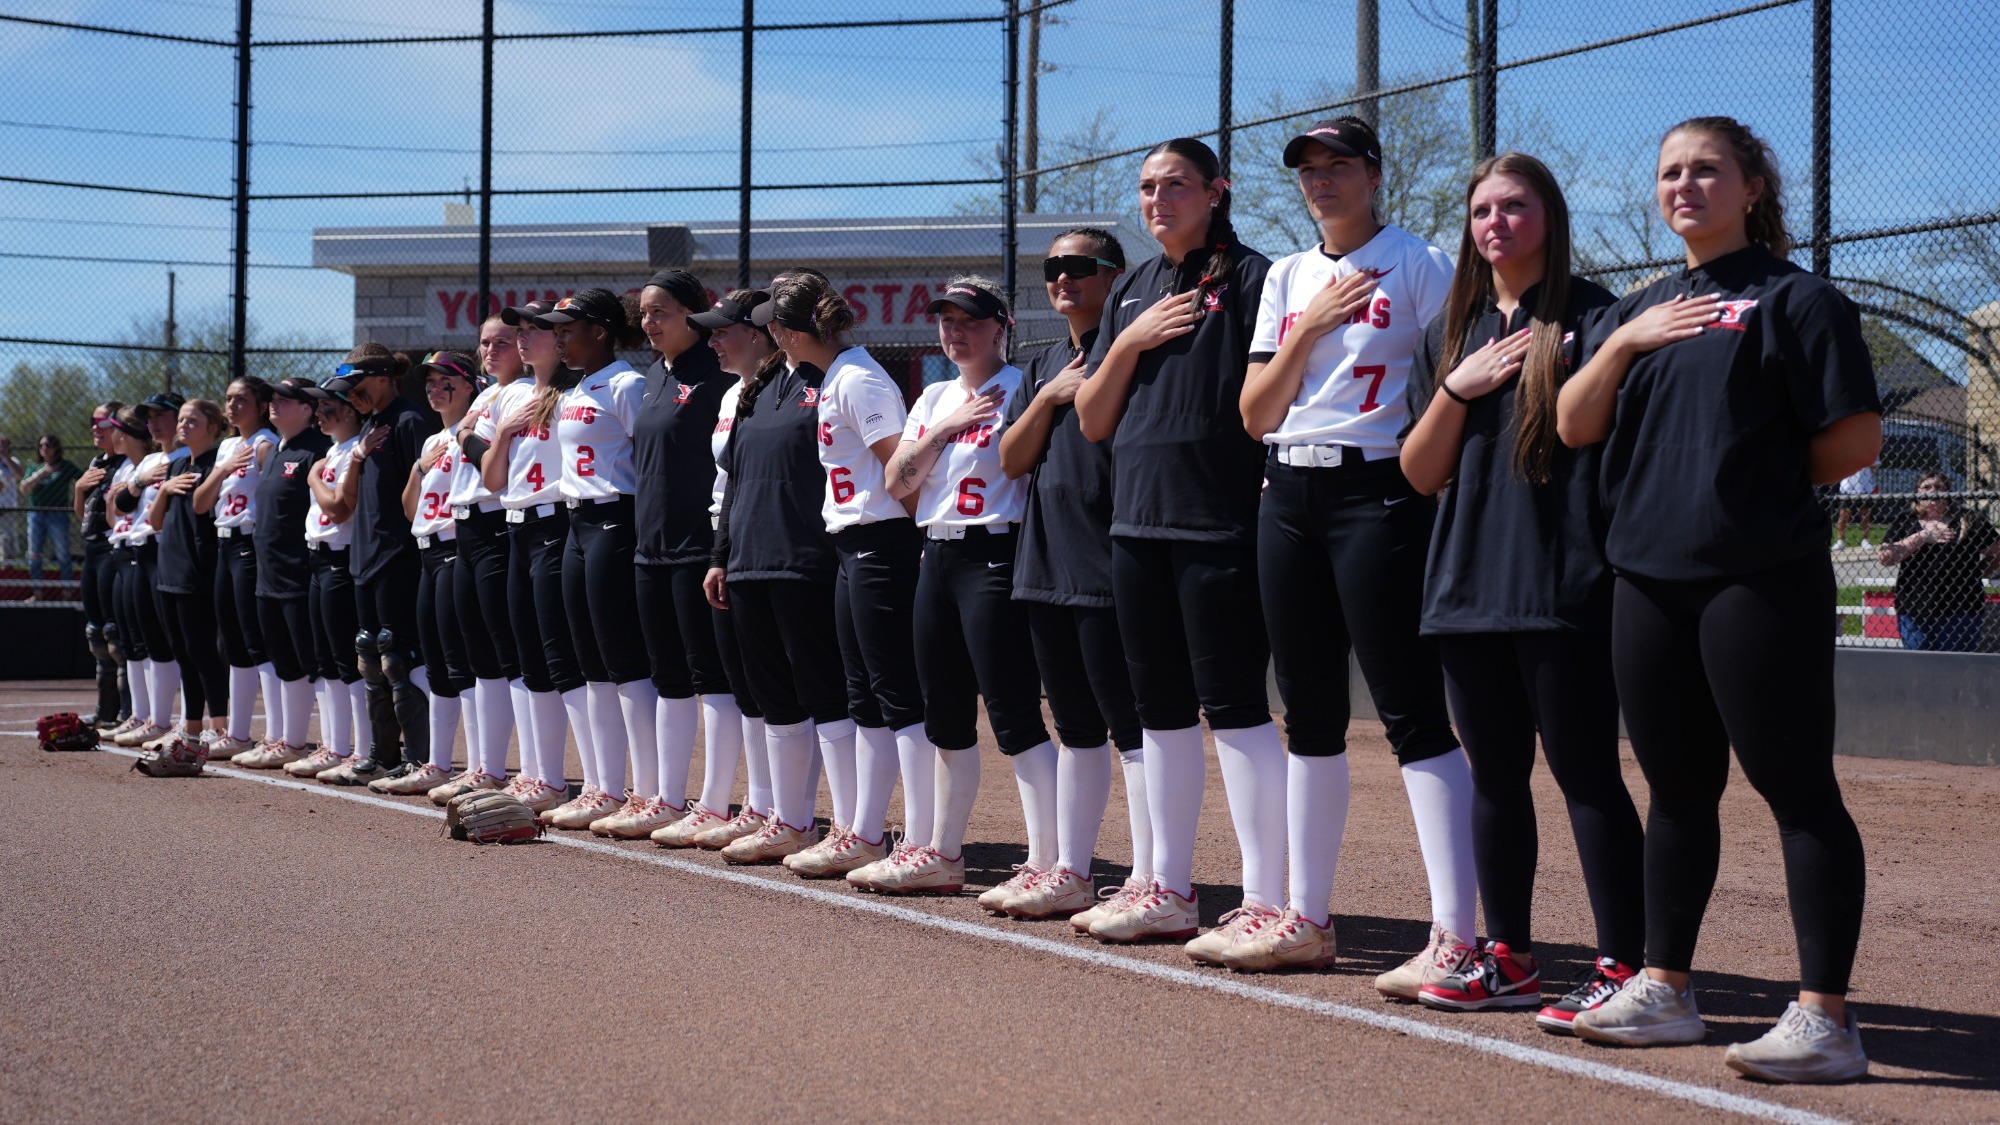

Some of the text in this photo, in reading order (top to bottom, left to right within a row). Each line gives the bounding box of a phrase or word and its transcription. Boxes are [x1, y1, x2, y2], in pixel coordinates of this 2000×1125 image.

[841, 284, 947, 324] STA
[1353, 364, 1386, 413] 7
[526, 462, 546, 494] 4
[577, 445, 595, 477] 2
[829, 466, 855, 505] 6
[956, 477, 987, 517] 6
